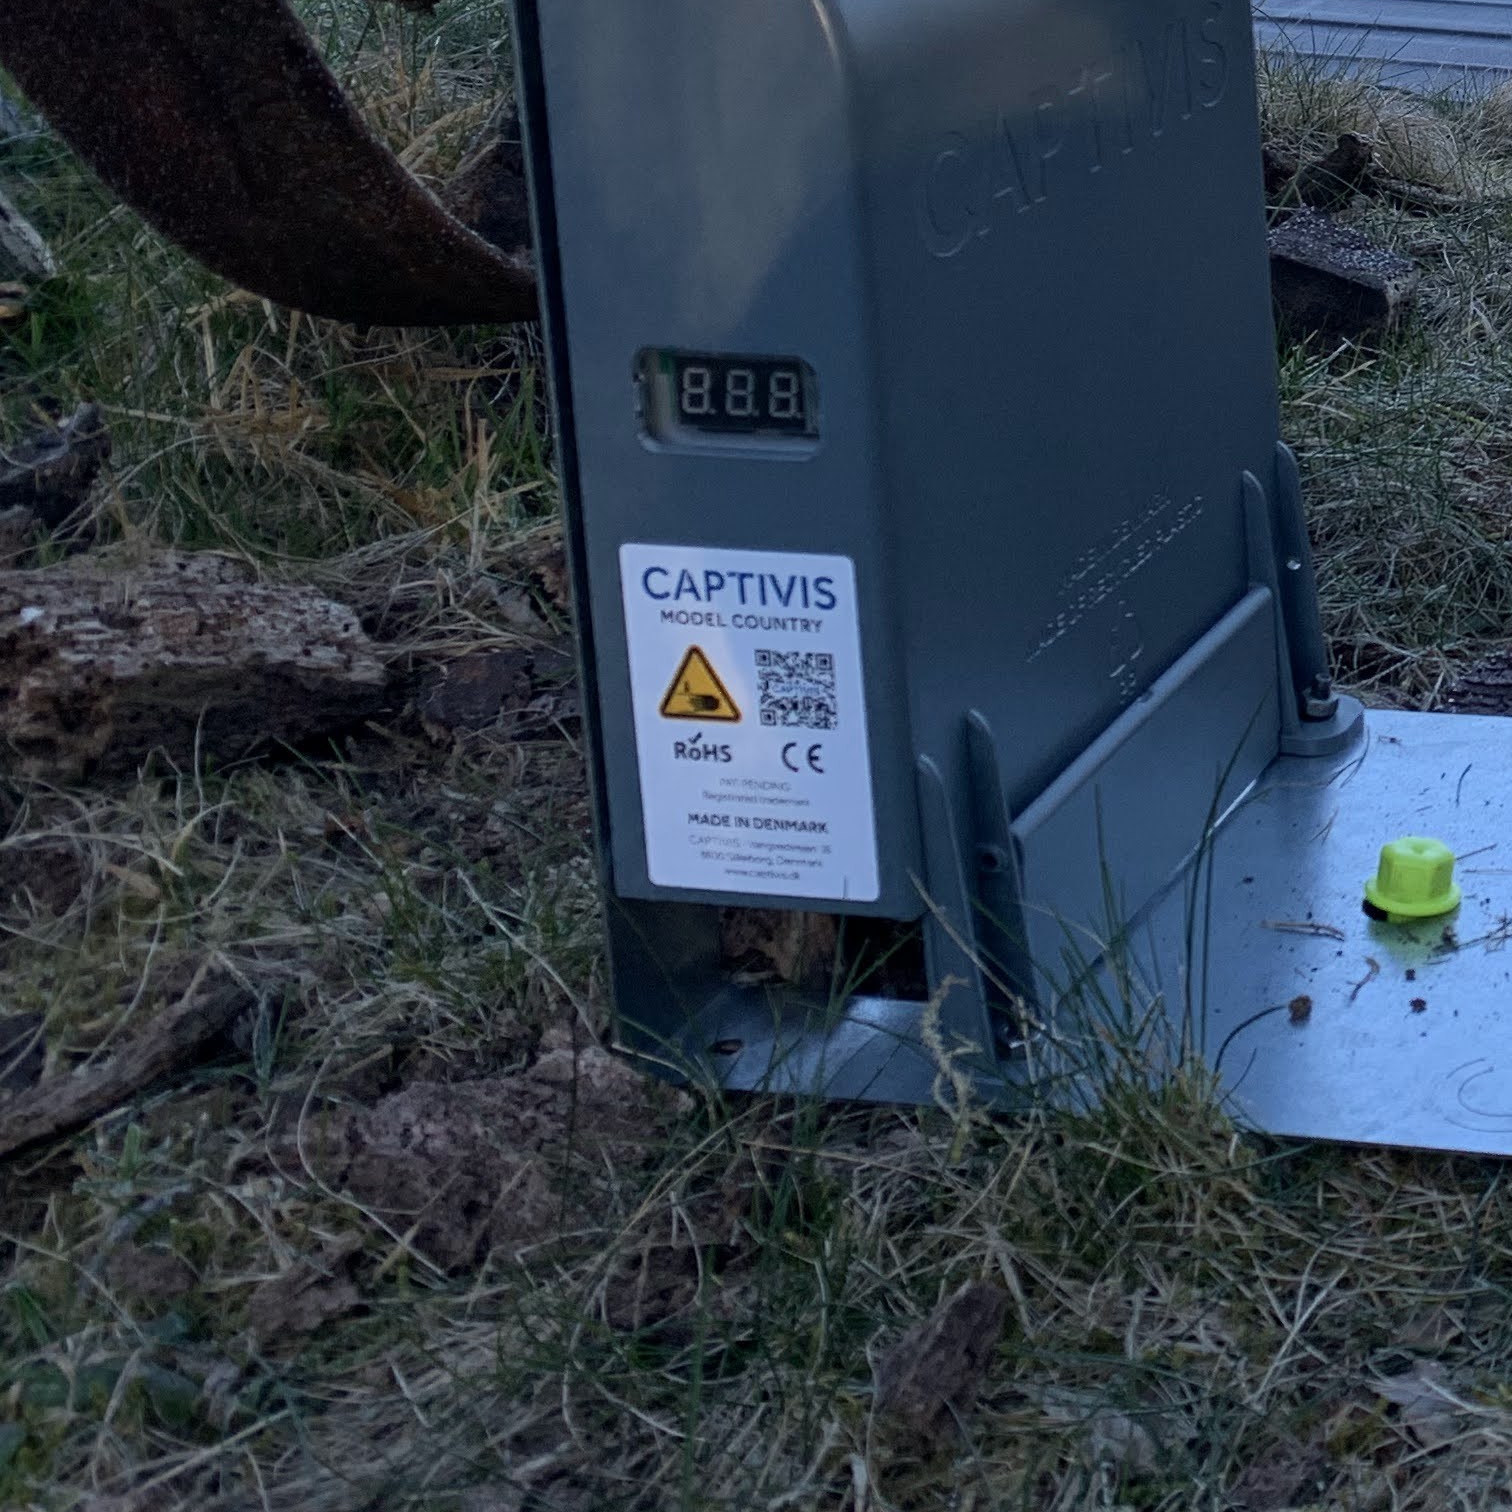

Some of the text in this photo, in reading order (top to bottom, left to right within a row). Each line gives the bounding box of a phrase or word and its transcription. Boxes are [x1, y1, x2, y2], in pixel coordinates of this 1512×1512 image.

[641, 565, 837, 611] CAPTIVIS
[659, 609, 822, 633] MODEL COUNTRY
[673, 741, 733, 763] RoHS
[781, 742, 825, 774] CE
[687, 813, 829, 835] MADE IN DENMARK
